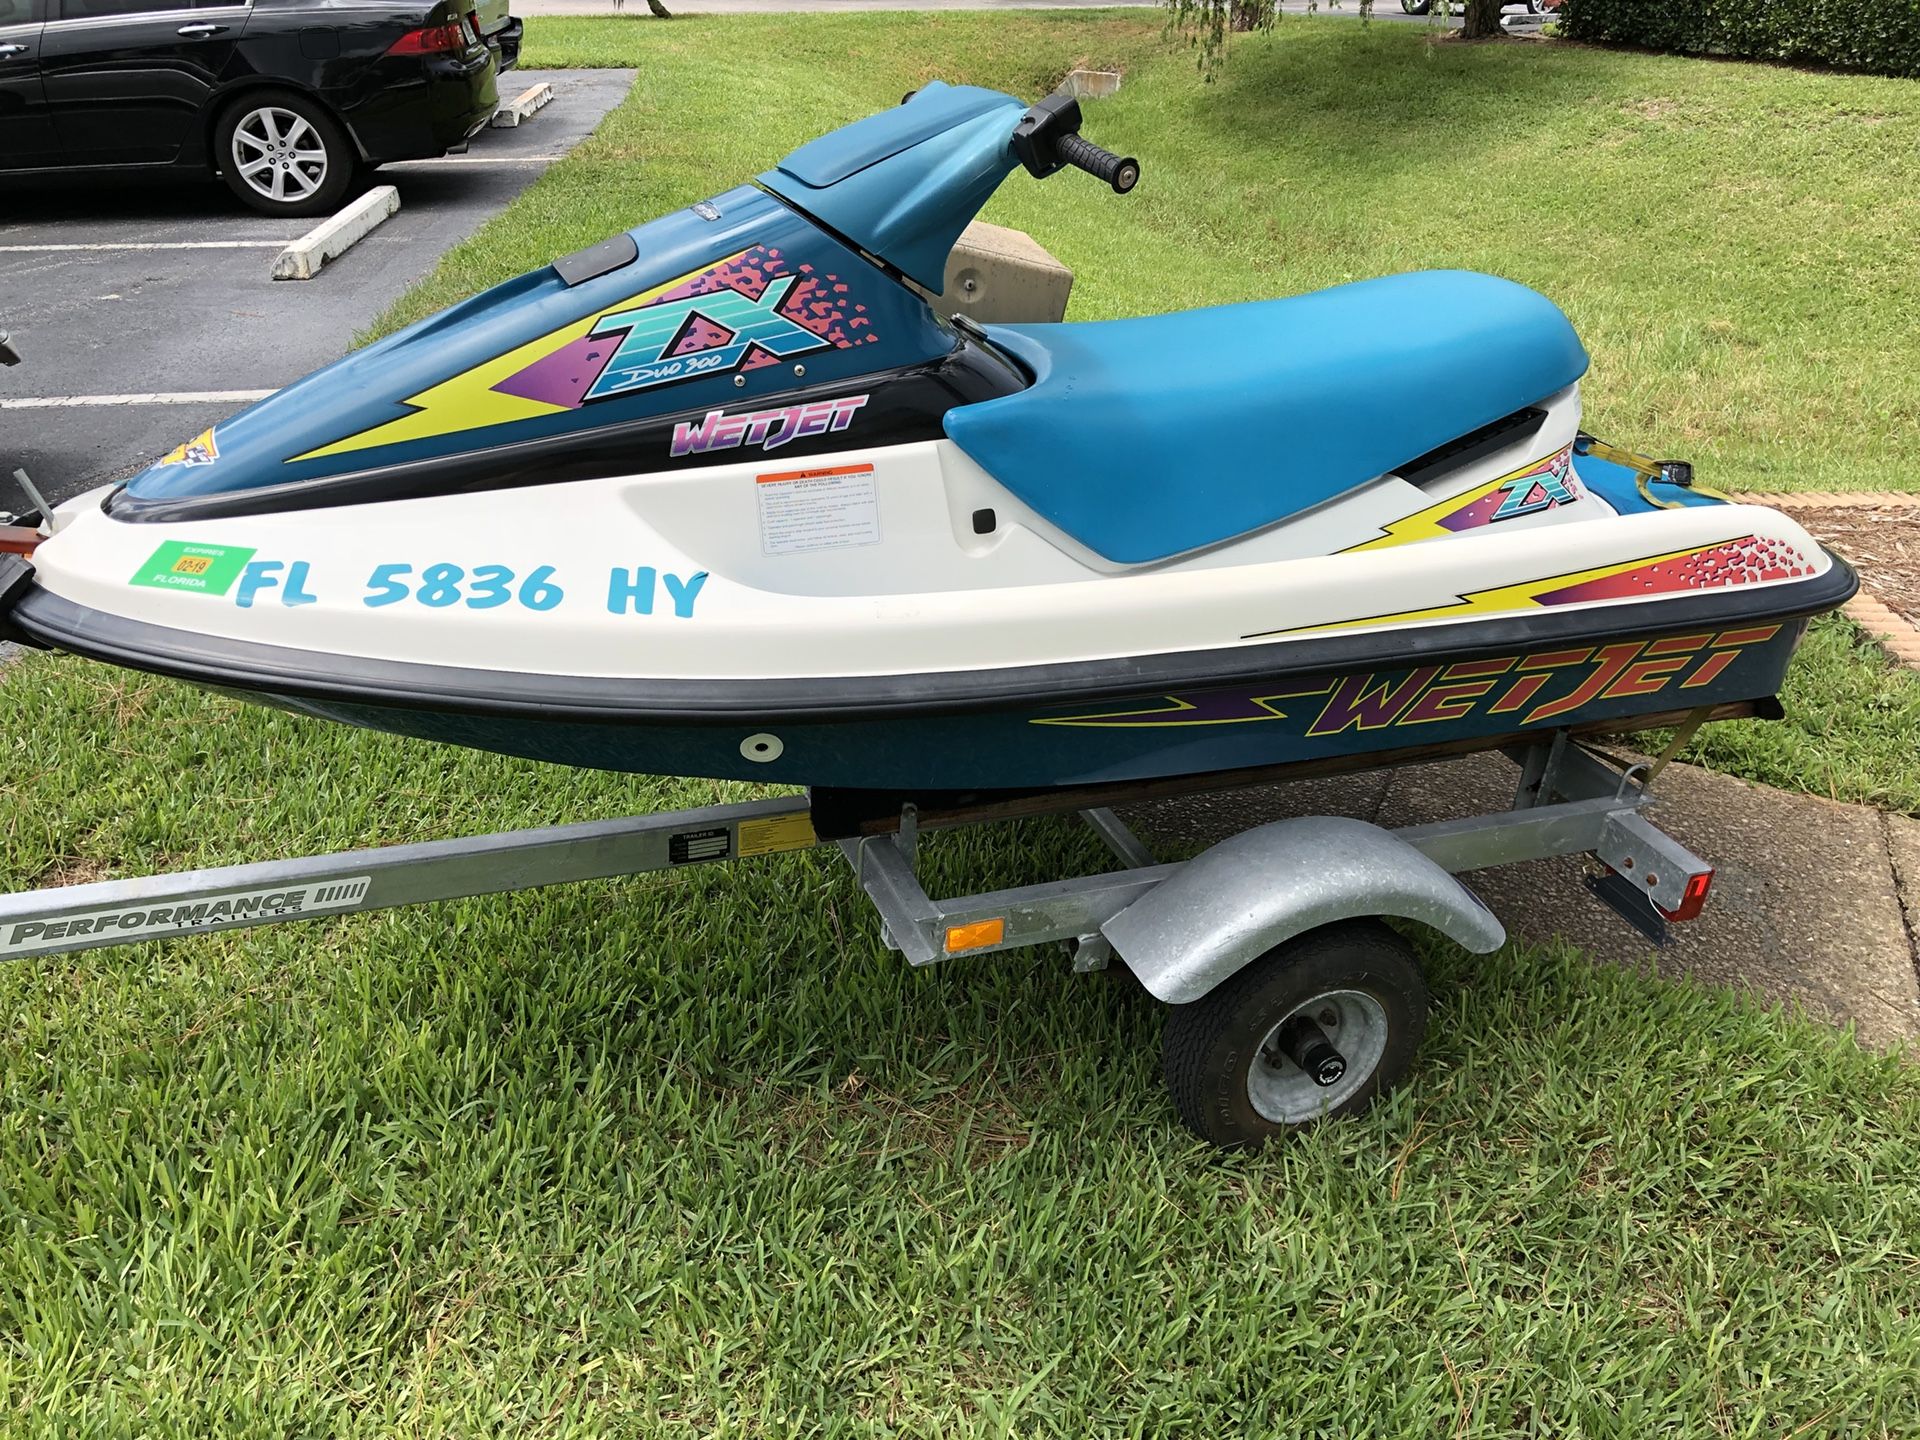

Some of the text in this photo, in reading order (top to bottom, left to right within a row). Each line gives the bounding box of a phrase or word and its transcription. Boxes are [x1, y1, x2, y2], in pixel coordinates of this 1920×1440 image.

[583, 273, 838, 402] ZX
[686, 355, 722, 373] 300
[669, 394, 870, 457] WETJET
[1489, 466, 1576, 522] ZX
[176, 560, 206, 573] 02-19
[183, 547, 225, 557] EXPIRES
[153, 575, 206, 587] FLORIDA
[236, 561, 709, 618] FL 5836 HY
[1304, 623, 1784, 738] WETJET
[9, 889, 307, 945] PERFORMANCE
[175, 905, 303, 929] TRAILERS
